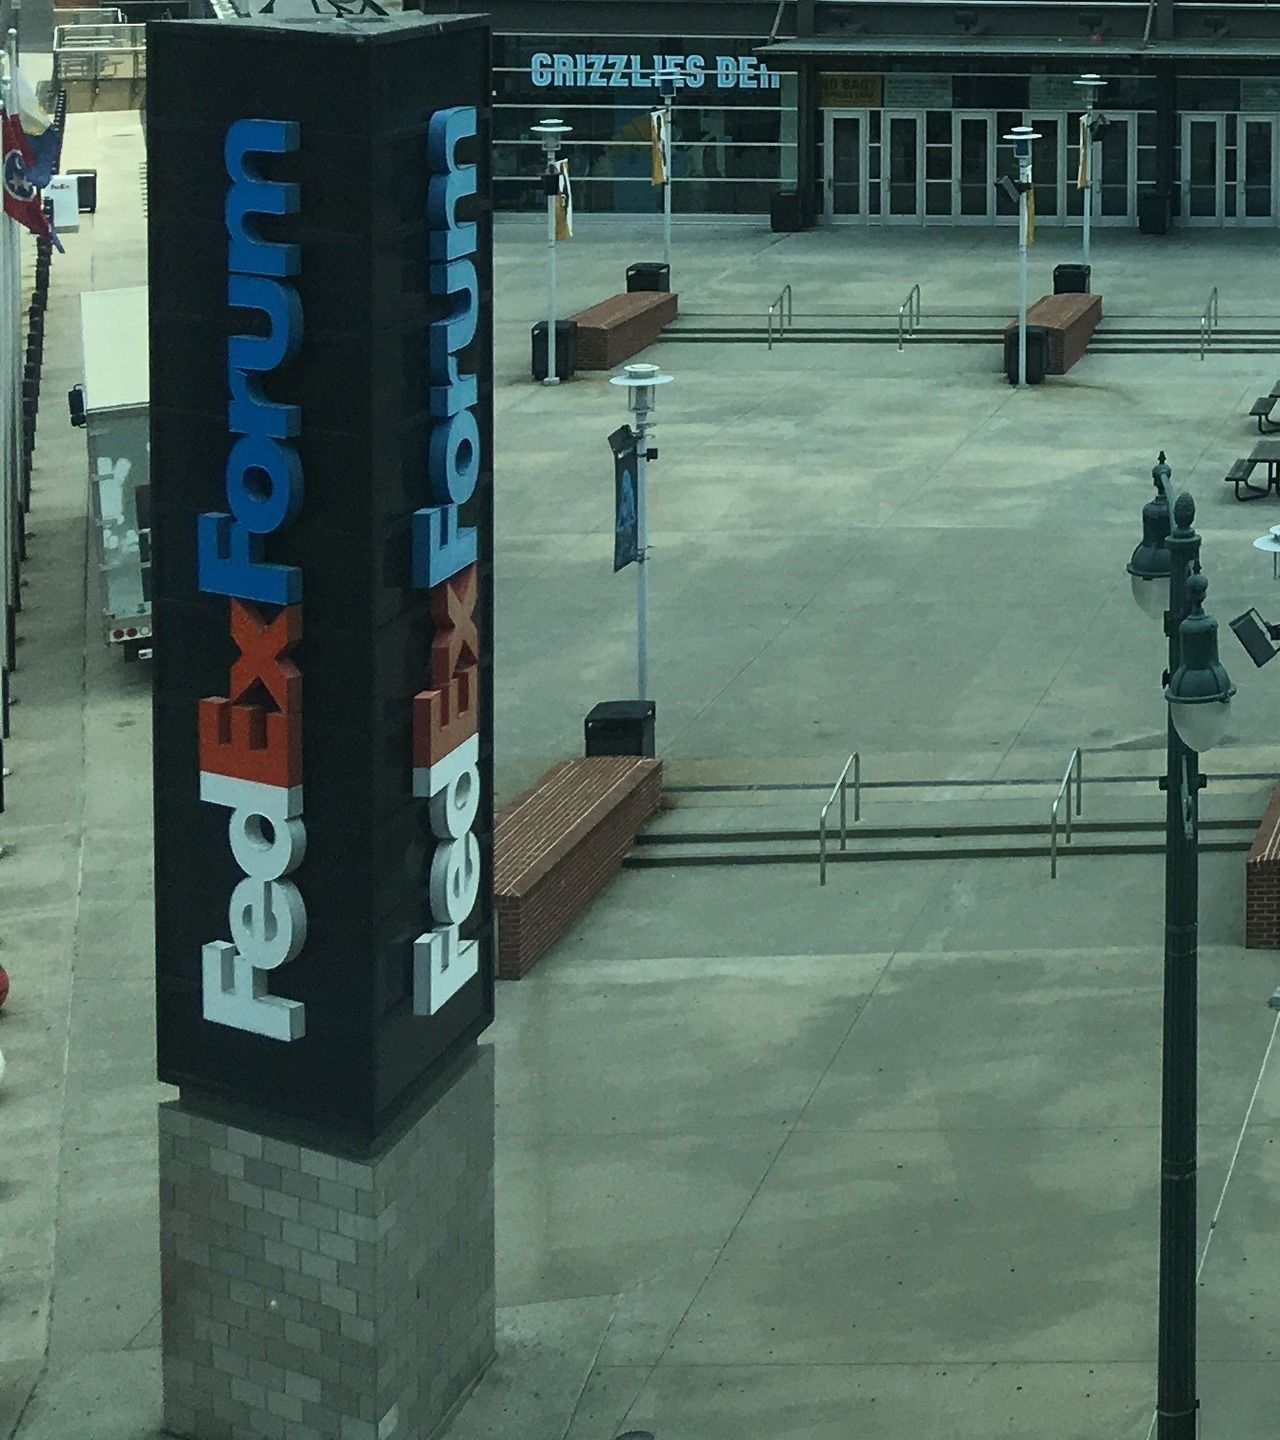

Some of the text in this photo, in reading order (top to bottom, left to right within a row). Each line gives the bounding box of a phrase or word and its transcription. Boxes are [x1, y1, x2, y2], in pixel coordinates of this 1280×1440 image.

[531, 52, 706, 88] GRIZZLIES
[197, 117, 306, 1043] FedExForum
[412, 105, 480, 1017] FedExForum
